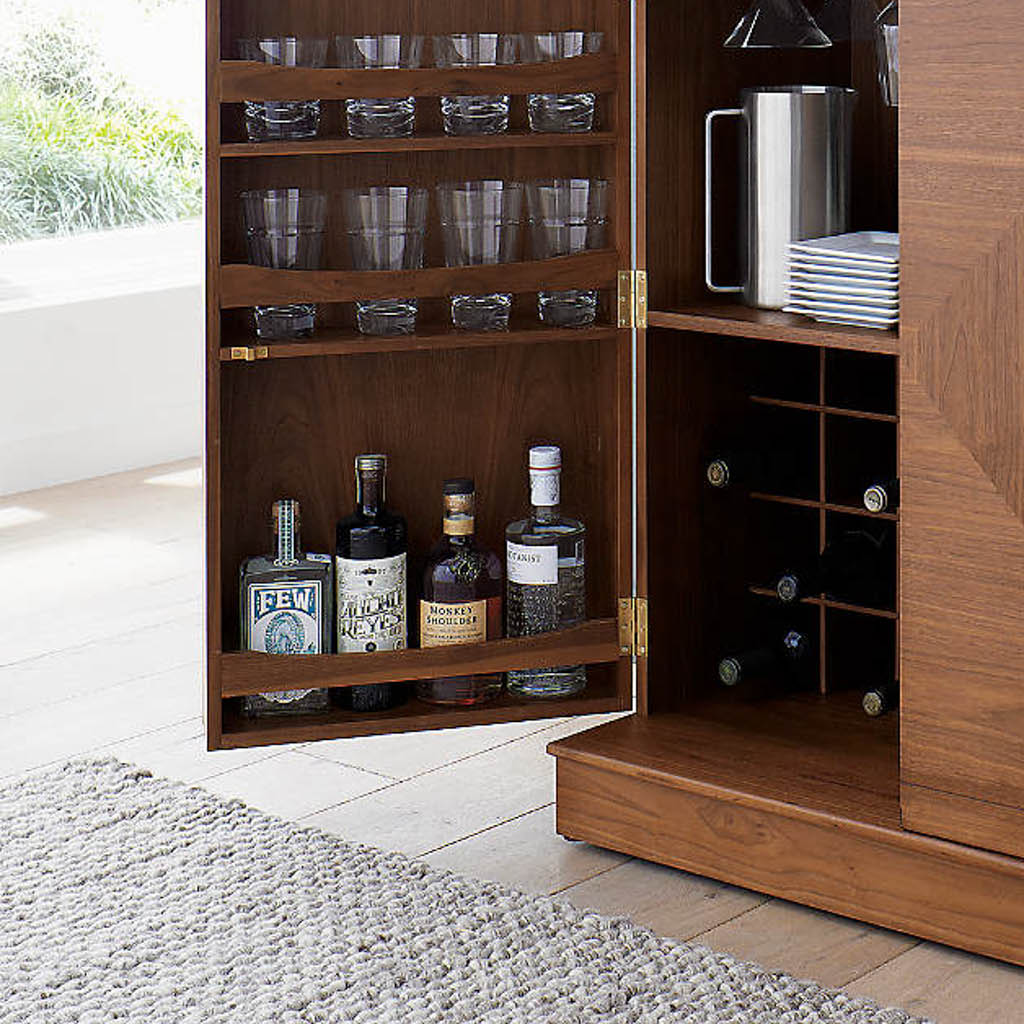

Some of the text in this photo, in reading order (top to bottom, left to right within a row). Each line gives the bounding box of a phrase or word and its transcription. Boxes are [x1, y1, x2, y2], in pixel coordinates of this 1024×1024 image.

[508, 550, 542, 563] OTANIST
[258, 588, 311, 615] FEW
[429, 605, 474, 616] MONKEY
[426, 615, 478, 626] SHOULDER
